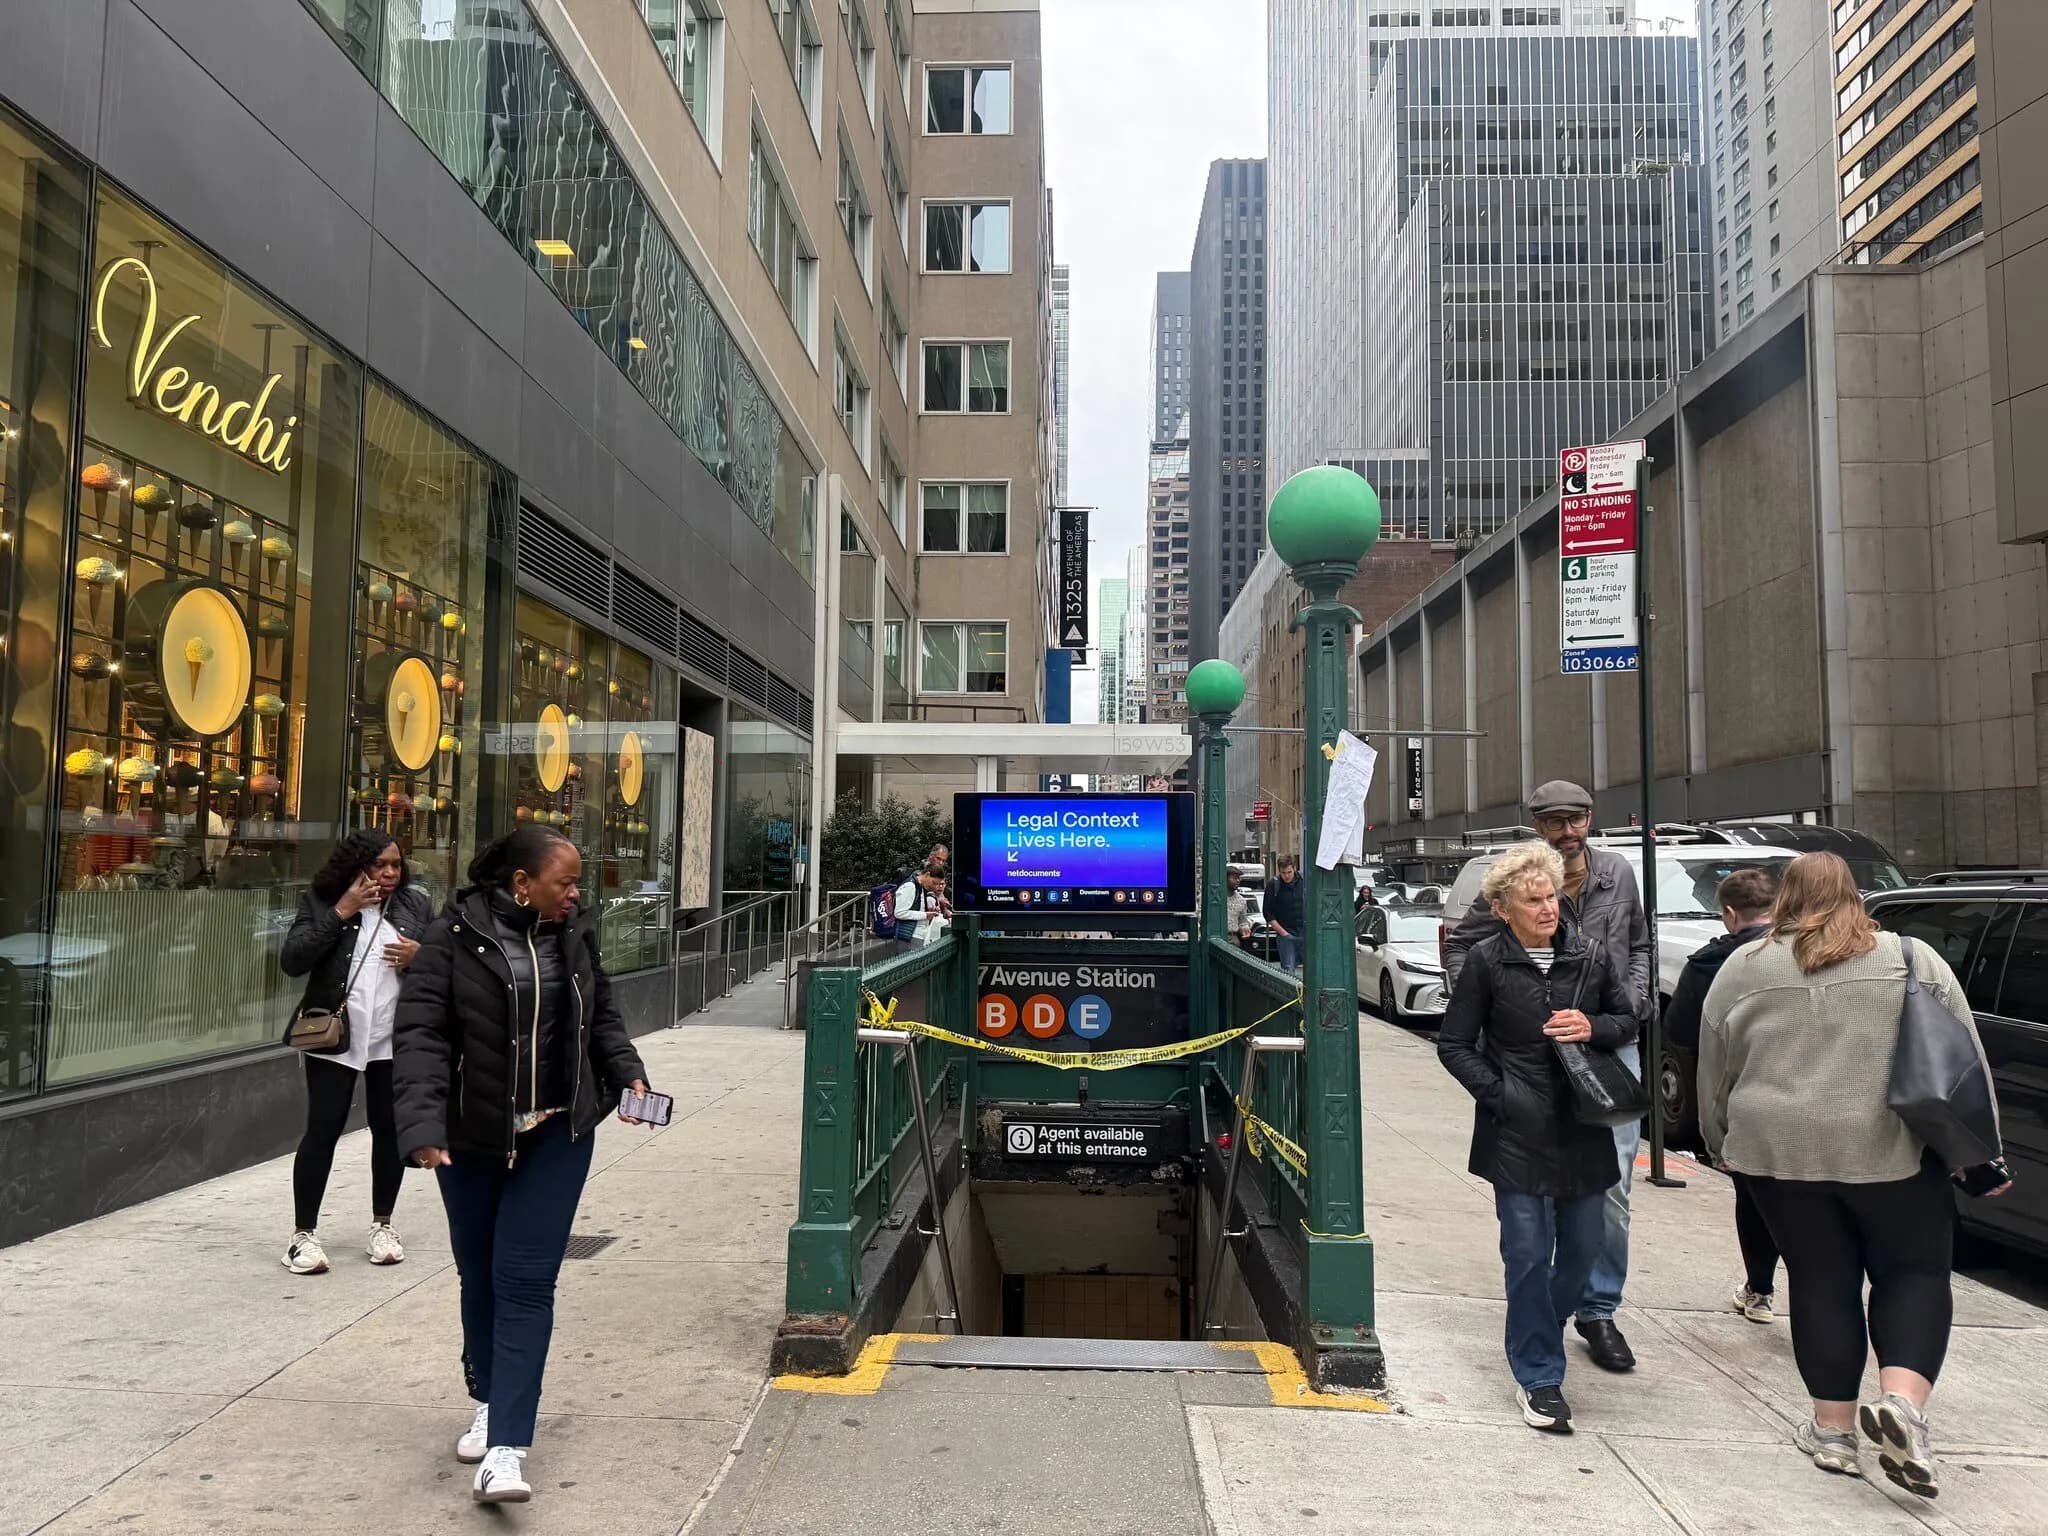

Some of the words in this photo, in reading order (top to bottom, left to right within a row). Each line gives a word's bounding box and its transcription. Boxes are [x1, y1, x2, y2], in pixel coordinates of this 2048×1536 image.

[97, 257, 297, 471] Venchi
[1590, 453, 1626, 462] Wednesday
[1564, 500, 1578, 510] NO
[1582, 494, 1632, 508] STANDING
[1564, 514, 1594, 523] Monday
[1602, 511, 1626, 520] Friday
[1588, 522, 1606, 531] 6pm
[1066, 530, 1074, 542] OF
[1567, 558, 1582, 579] 6
[1590, 563, 1618, 571] metered
[1590, 570, 1615, 578] parking
[1564, 586, 1594, 594] Monday
[1602, 584, 1626, 592] Friday
[1066, 580, 1082, 621] 1325
[1564, 596, 1582, 605] 6pm
[1590, 594, 1621, 603] Midnight
[1565, 608, 1600, 618] Saturday
[1565, 619, 1582, 627] 8am
[1590, 616, 1621, 626] Midnight
[1118, 738, 1143, 752] 159
[1007, 812, 1058, 831] Legal
[1063, 812, 1139, 828] Context
[1007, 832, 1056, 848] Lives
[1060, 832, 1110, 848] Here.
[1007, 869, 1060, 878] netdocuments
[978, 966, 988, 986] 7
[990, 966, 1070, 987] Avenue
[1076, 966, 1156, 988] Station
[986, 1002, 1006, 1028] B
[1034, 1003, 1056, 1028] D
[1080, 1004, 1100, 1030] E
[1038, 1126, 1080, 1142] Agent
[1084, 1128, 1144, 1141] available
[1038, 1143, 1052, 1154] at
[1057, 1142, 1082, 1154] this
[1086, 1145, 1148, 1156] entrance
